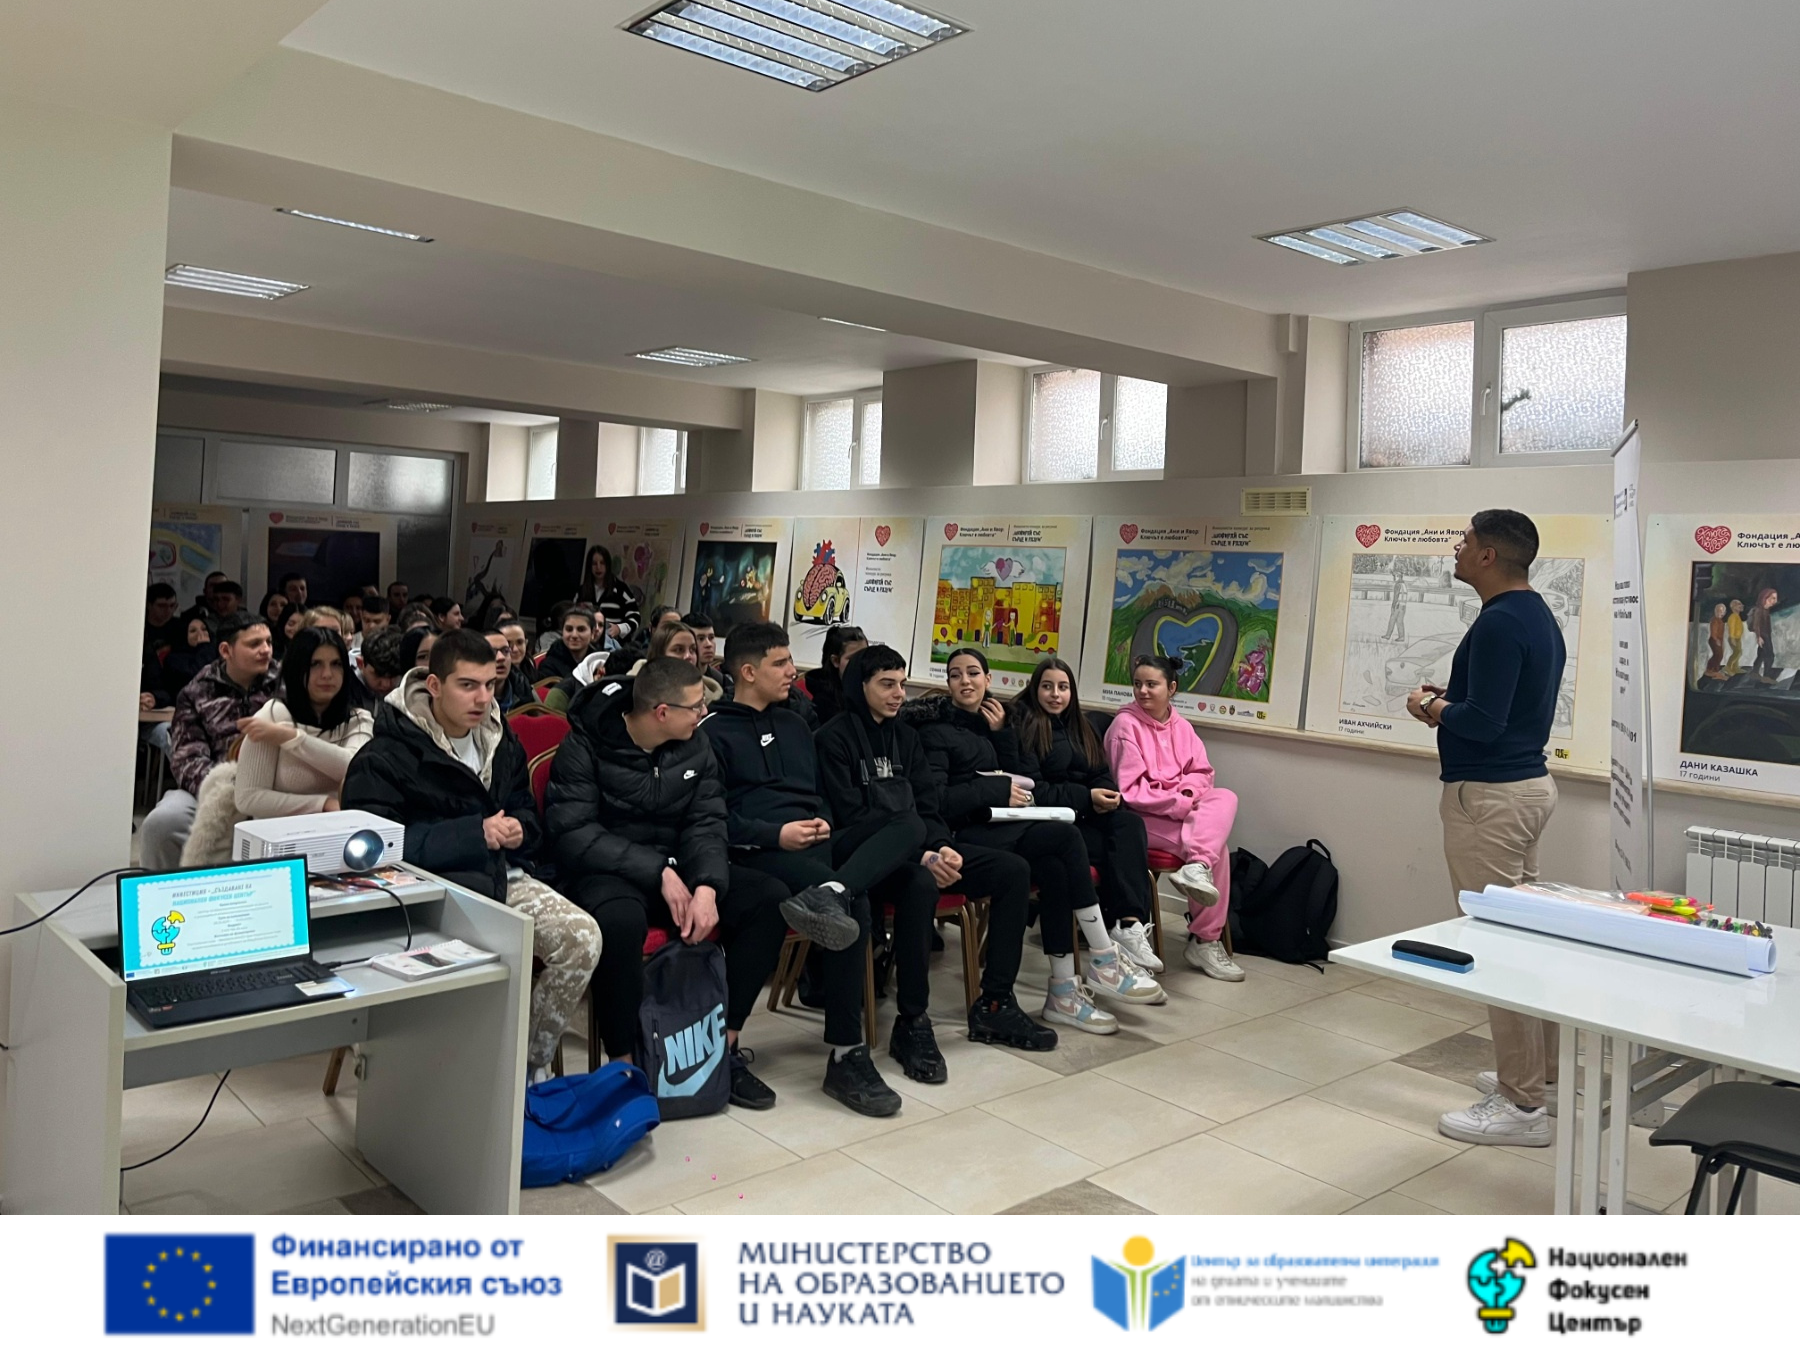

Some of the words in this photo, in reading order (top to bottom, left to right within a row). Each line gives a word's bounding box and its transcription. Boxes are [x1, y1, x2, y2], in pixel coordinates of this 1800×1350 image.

[1384, 528, 1420, 537] Фондация
[1737, 532, 1789, 541] Фондация
[1737, 541, 1775, 549] Ключът
[1338, 718, 1356, 726] ИВАН
[1357, 721, 1392, 731] АХЧИЙСКИ
[1344, 727, 1365, 735] години
[1679, 760, 1708, 771] ДАНИ
[1710, 763, 1759, 777] КАЗАШКА
[1679, 770, 1688, 778] 17
[1688, 772, 1721, 782] години
[664, 1003, 726, 1076] NIKE
